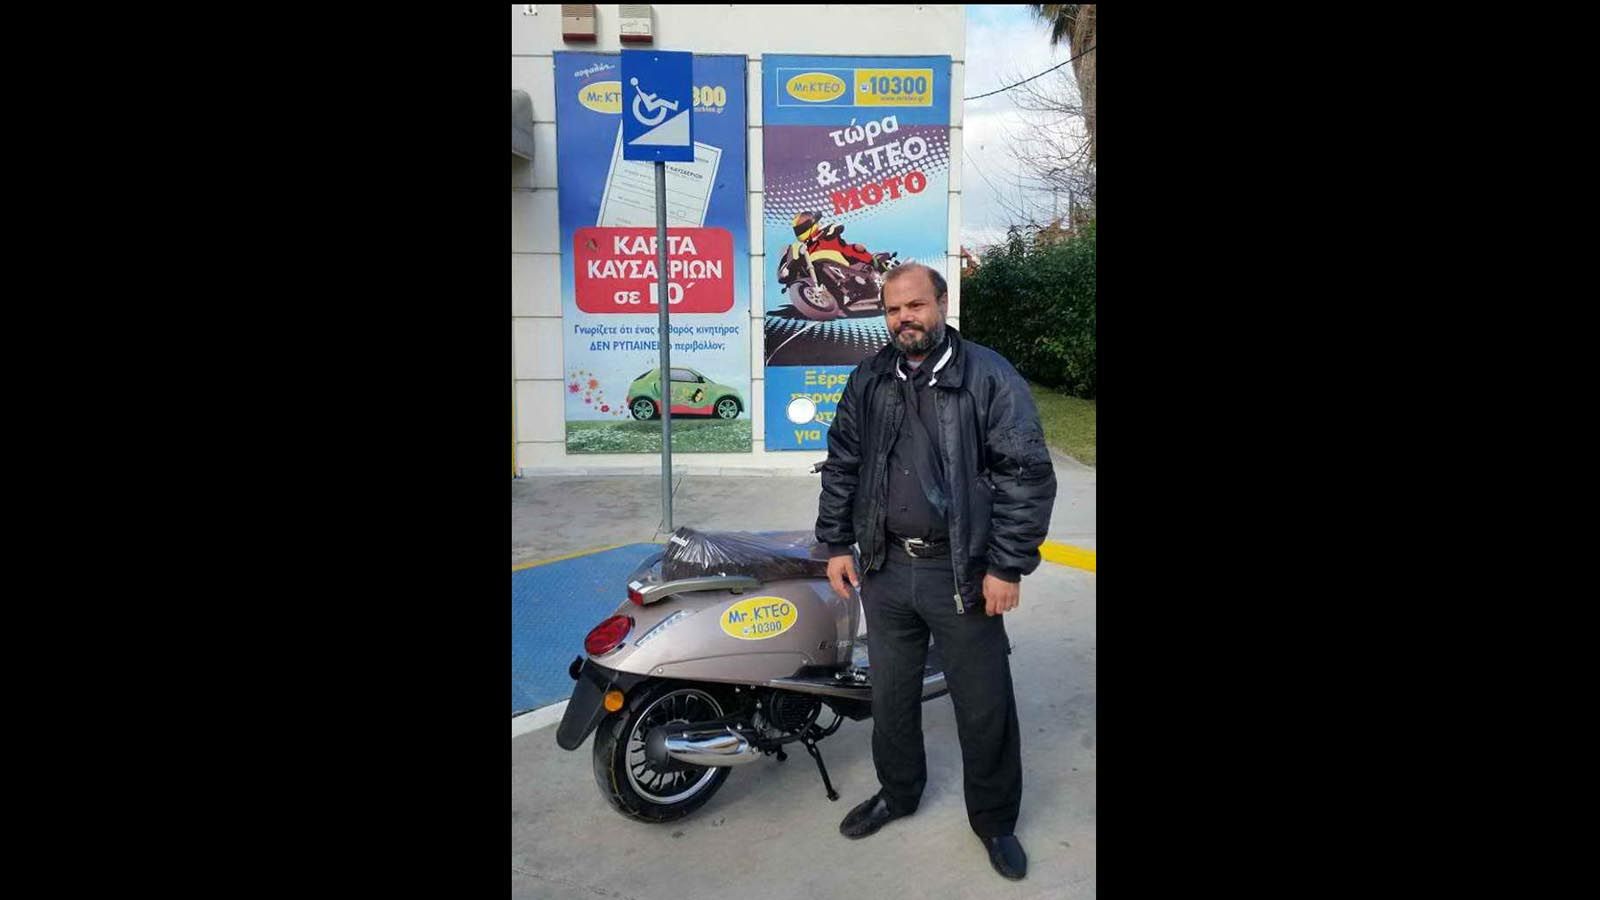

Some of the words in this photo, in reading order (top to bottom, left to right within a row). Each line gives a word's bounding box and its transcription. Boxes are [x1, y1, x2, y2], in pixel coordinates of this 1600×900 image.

[870, 76, 927, 95] 10300
[586, 91, 621, 104] Mr.KT
[693, 85, 727, 107] 300
[829, 115, 899, 147] τώρα
[816, 160, 841, 187] &
[845, 136, 928, 178] ΚΤΕΟ
[829, 171, 928, 216] ΜΟΤΟ
[587, 259, 723, 280] ΚΑΥΣΑΡΙΩΝ
[613, 290, 641, 305] σε
[589, 340, 610, 351] ΔΕΝ
[804, 370, 849, 389] Ξέρε
[794, 429, 821, 445] για
[751, 620, 782, 634] 10300
